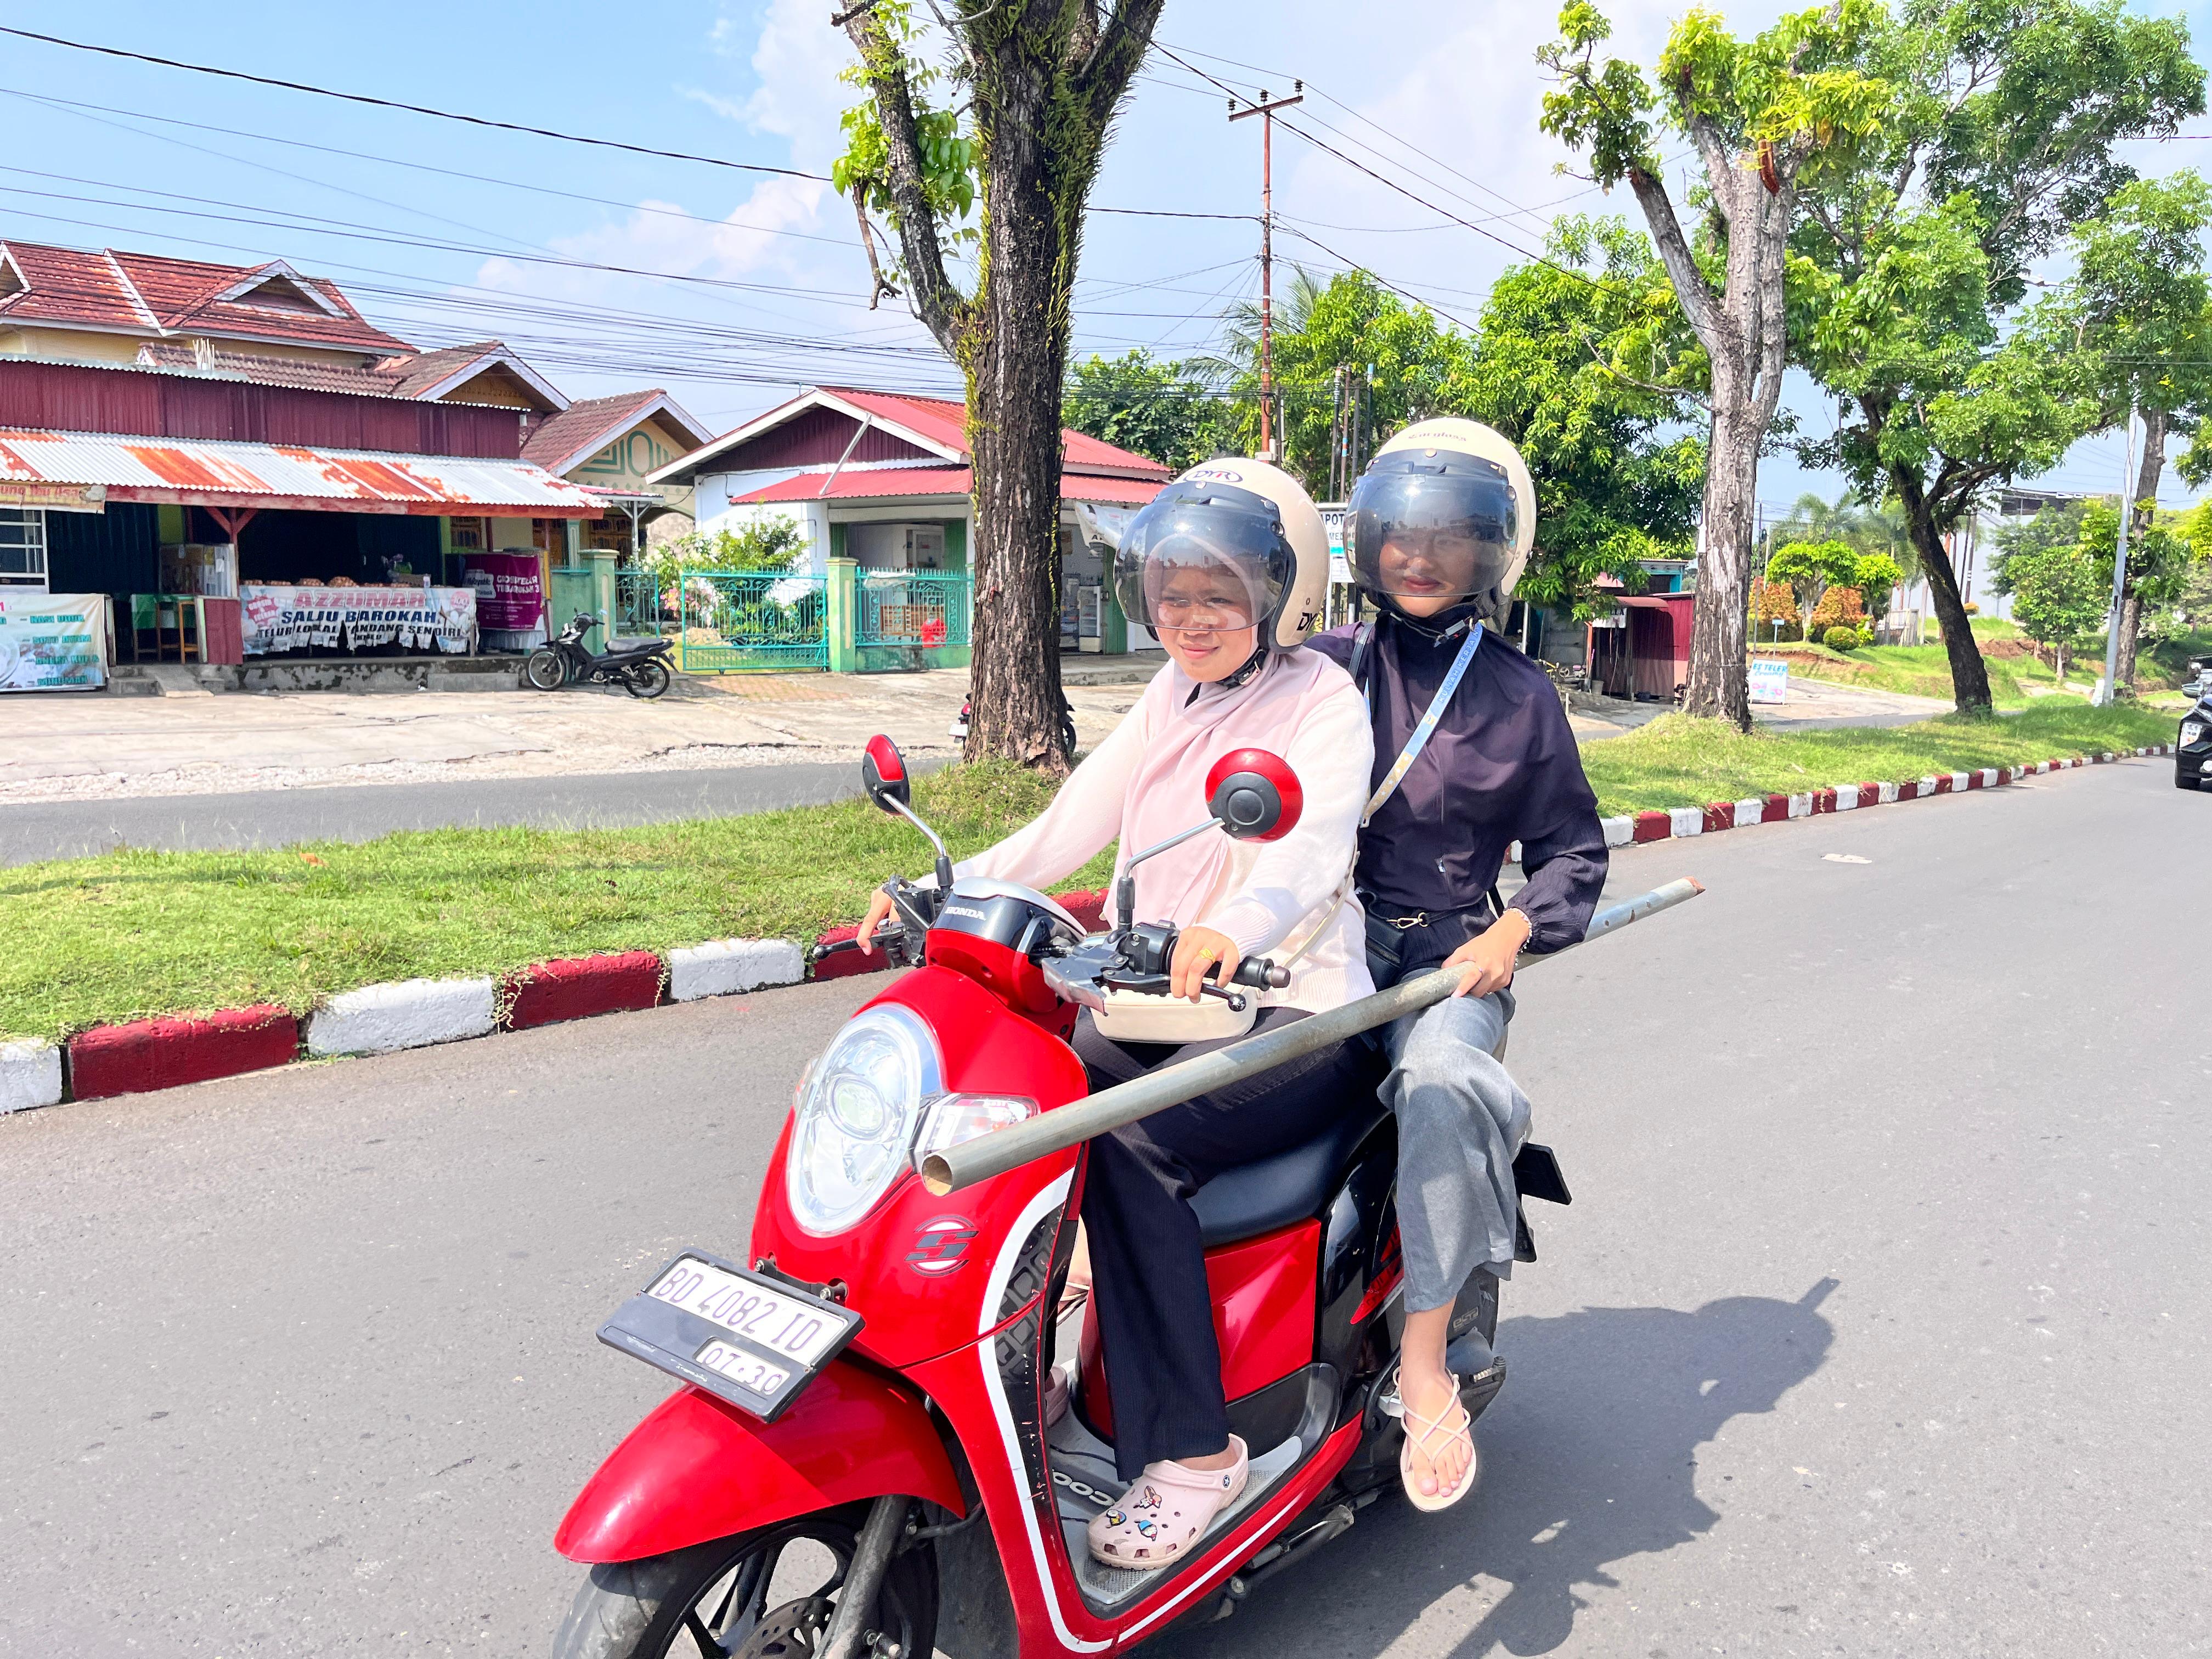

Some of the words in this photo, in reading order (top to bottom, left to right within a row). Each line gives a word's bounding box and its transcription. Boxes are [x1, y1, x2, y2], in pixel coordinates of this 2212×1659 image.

[1321, 514, 1344, 526] POT
[294, 592, 426, 608] AZZUMAR
[281, 611, 339, 624] SALJU
[346, 610, 437, 623] BAROKAH
[1438, 669, 1460, 703] KULIAH
[1457, 640, 1475, 668] KERJA
[944, 906, 987, 921] HONDA
[657, 1268, 704, 1304] BD
[697, 1284, 778, 1334] 4082
